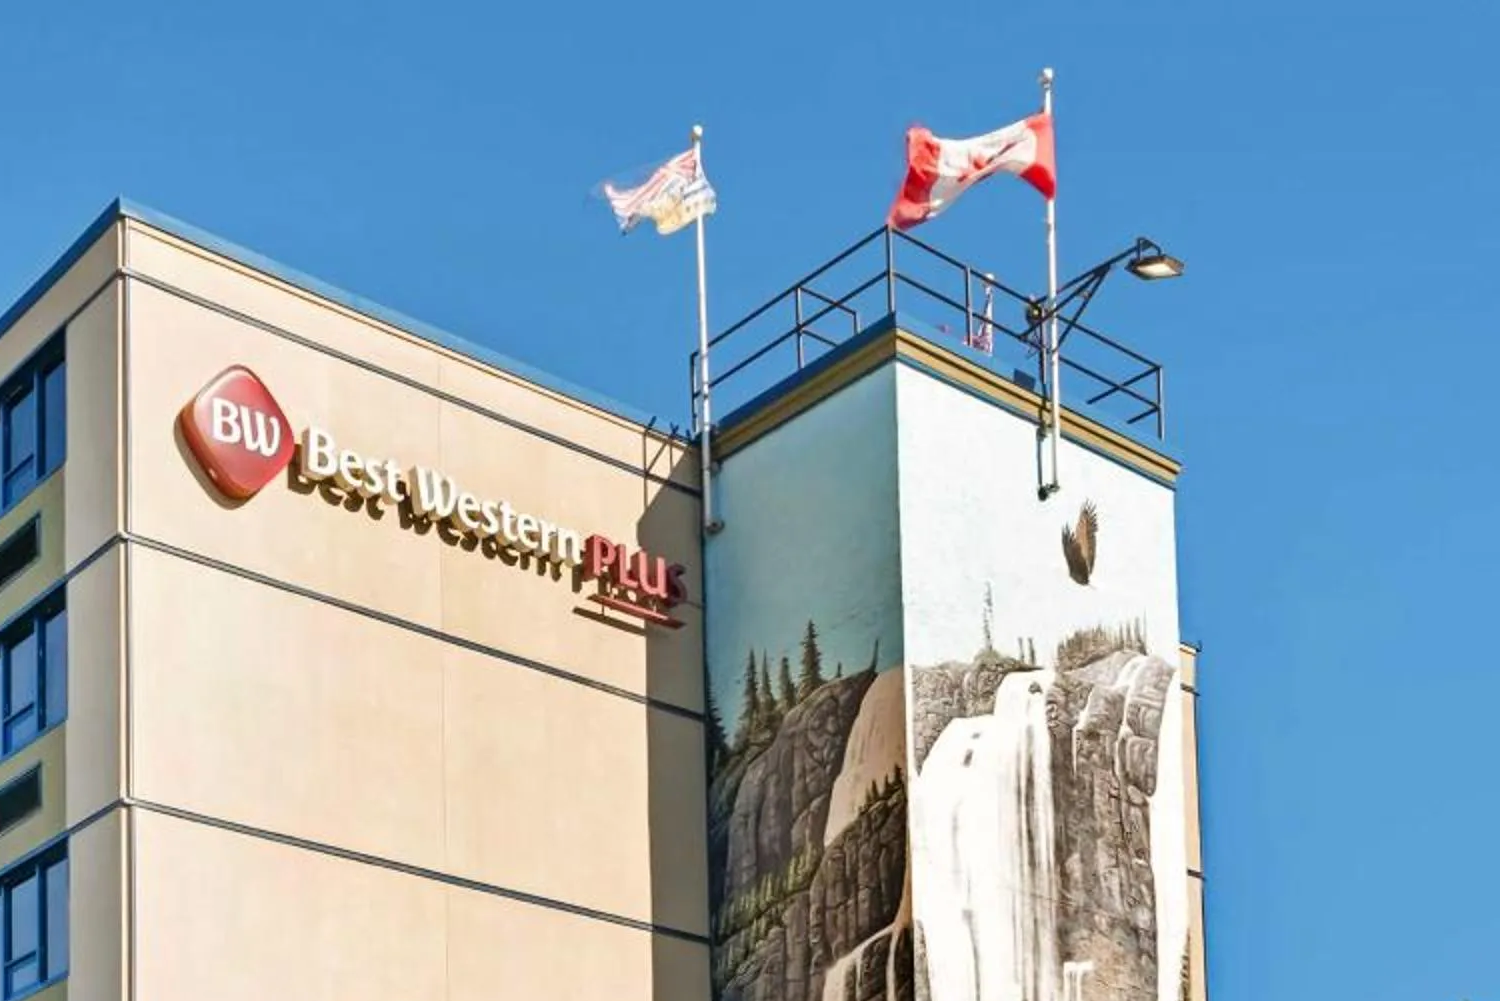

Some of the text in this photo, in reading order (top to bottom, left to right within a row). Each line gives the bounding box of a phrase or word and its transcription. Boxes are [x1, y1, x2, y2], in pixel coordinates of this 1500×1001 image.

[211, 398, 281, 457] BW
[306, 426, 688, 608] Best Western PLUS
